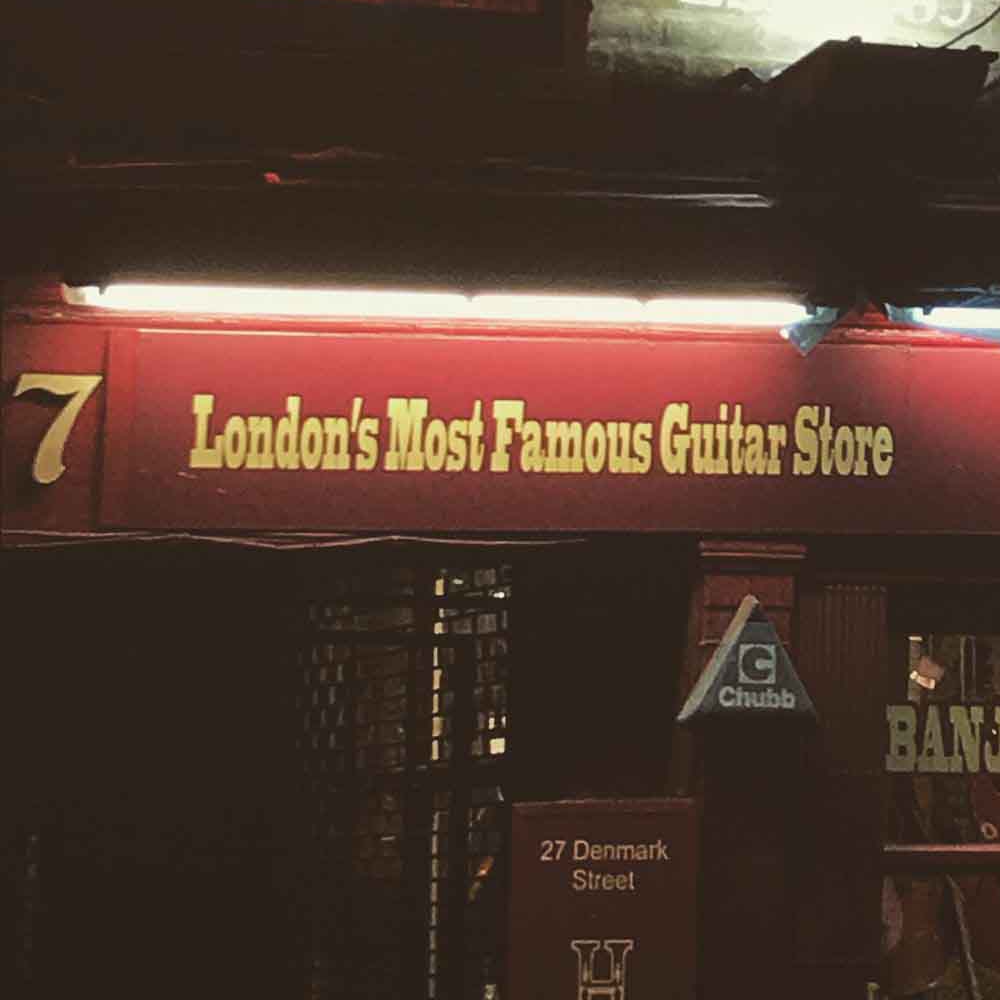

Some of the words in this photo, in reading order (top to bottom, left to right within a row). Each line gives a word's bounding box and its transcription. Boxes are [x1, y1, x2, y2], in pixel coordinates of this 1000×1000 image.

[189, 394, 381, 472] London's
[386, 397, 486, 473] Most
[492, 400, 653, 475] Famous
[659, 401, 786, 476] Guitar
[792, 403, 894, 477] Store
[718, 685, 796, 709] Chubb
[540, 839, 567, 861] 27
[572, 839, 669, 861] Denmark
[572, 868, 635, 891] Street
